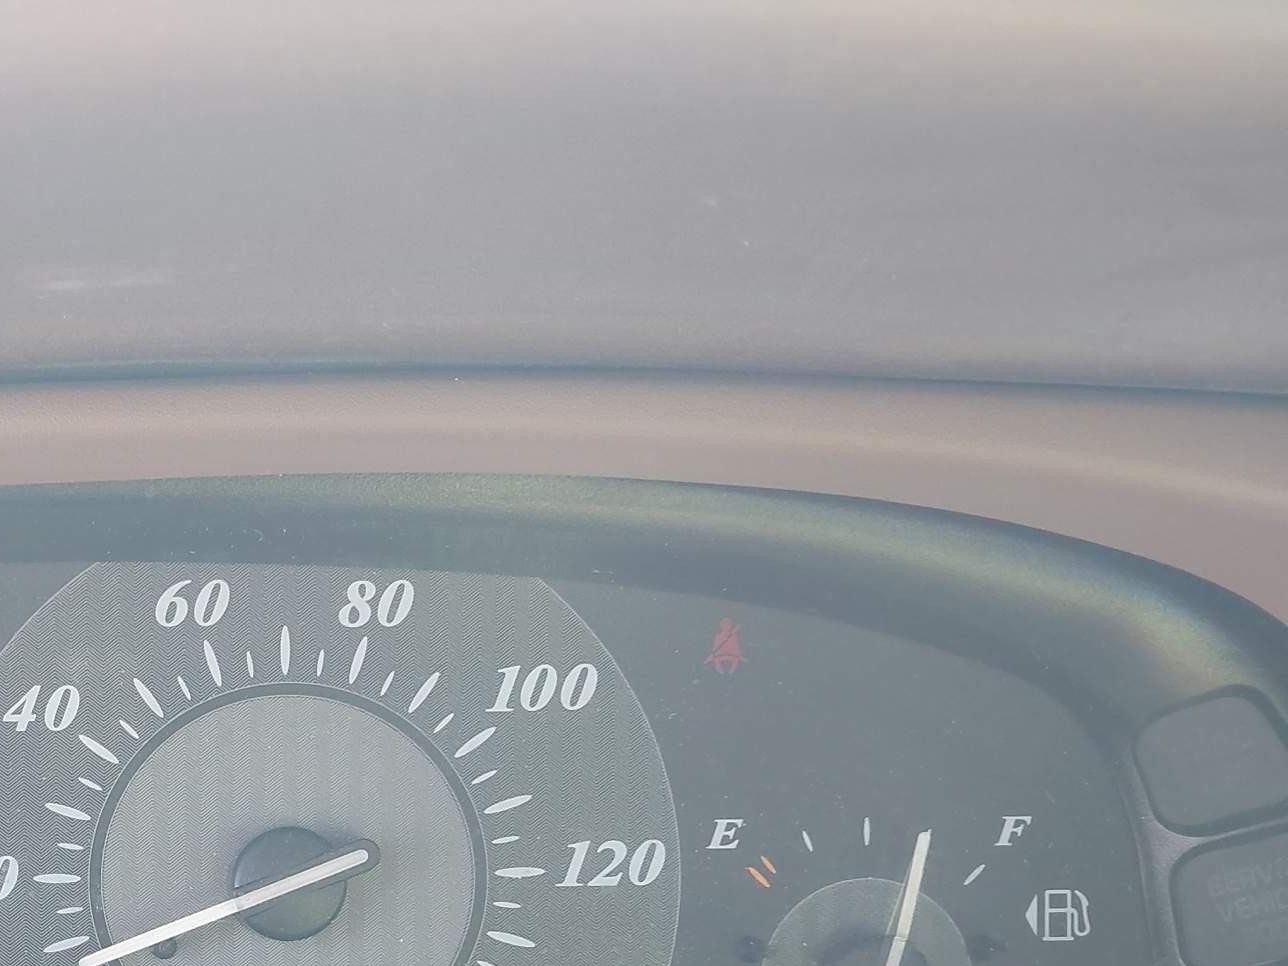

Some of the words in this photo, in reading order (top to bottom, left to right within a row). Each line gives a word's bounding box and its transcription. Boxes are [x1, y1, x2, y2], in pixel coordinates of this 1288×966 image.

[155, 579, 230, 628] 60
[338, 579, 415, 628] 80
[2, 684, 80, 732] 40
[485, 663, 598, 712] 100
[707, 818, 743, 849] E
[994, 815, 1032, 847] F
[555, 839, 666, 887] 120
